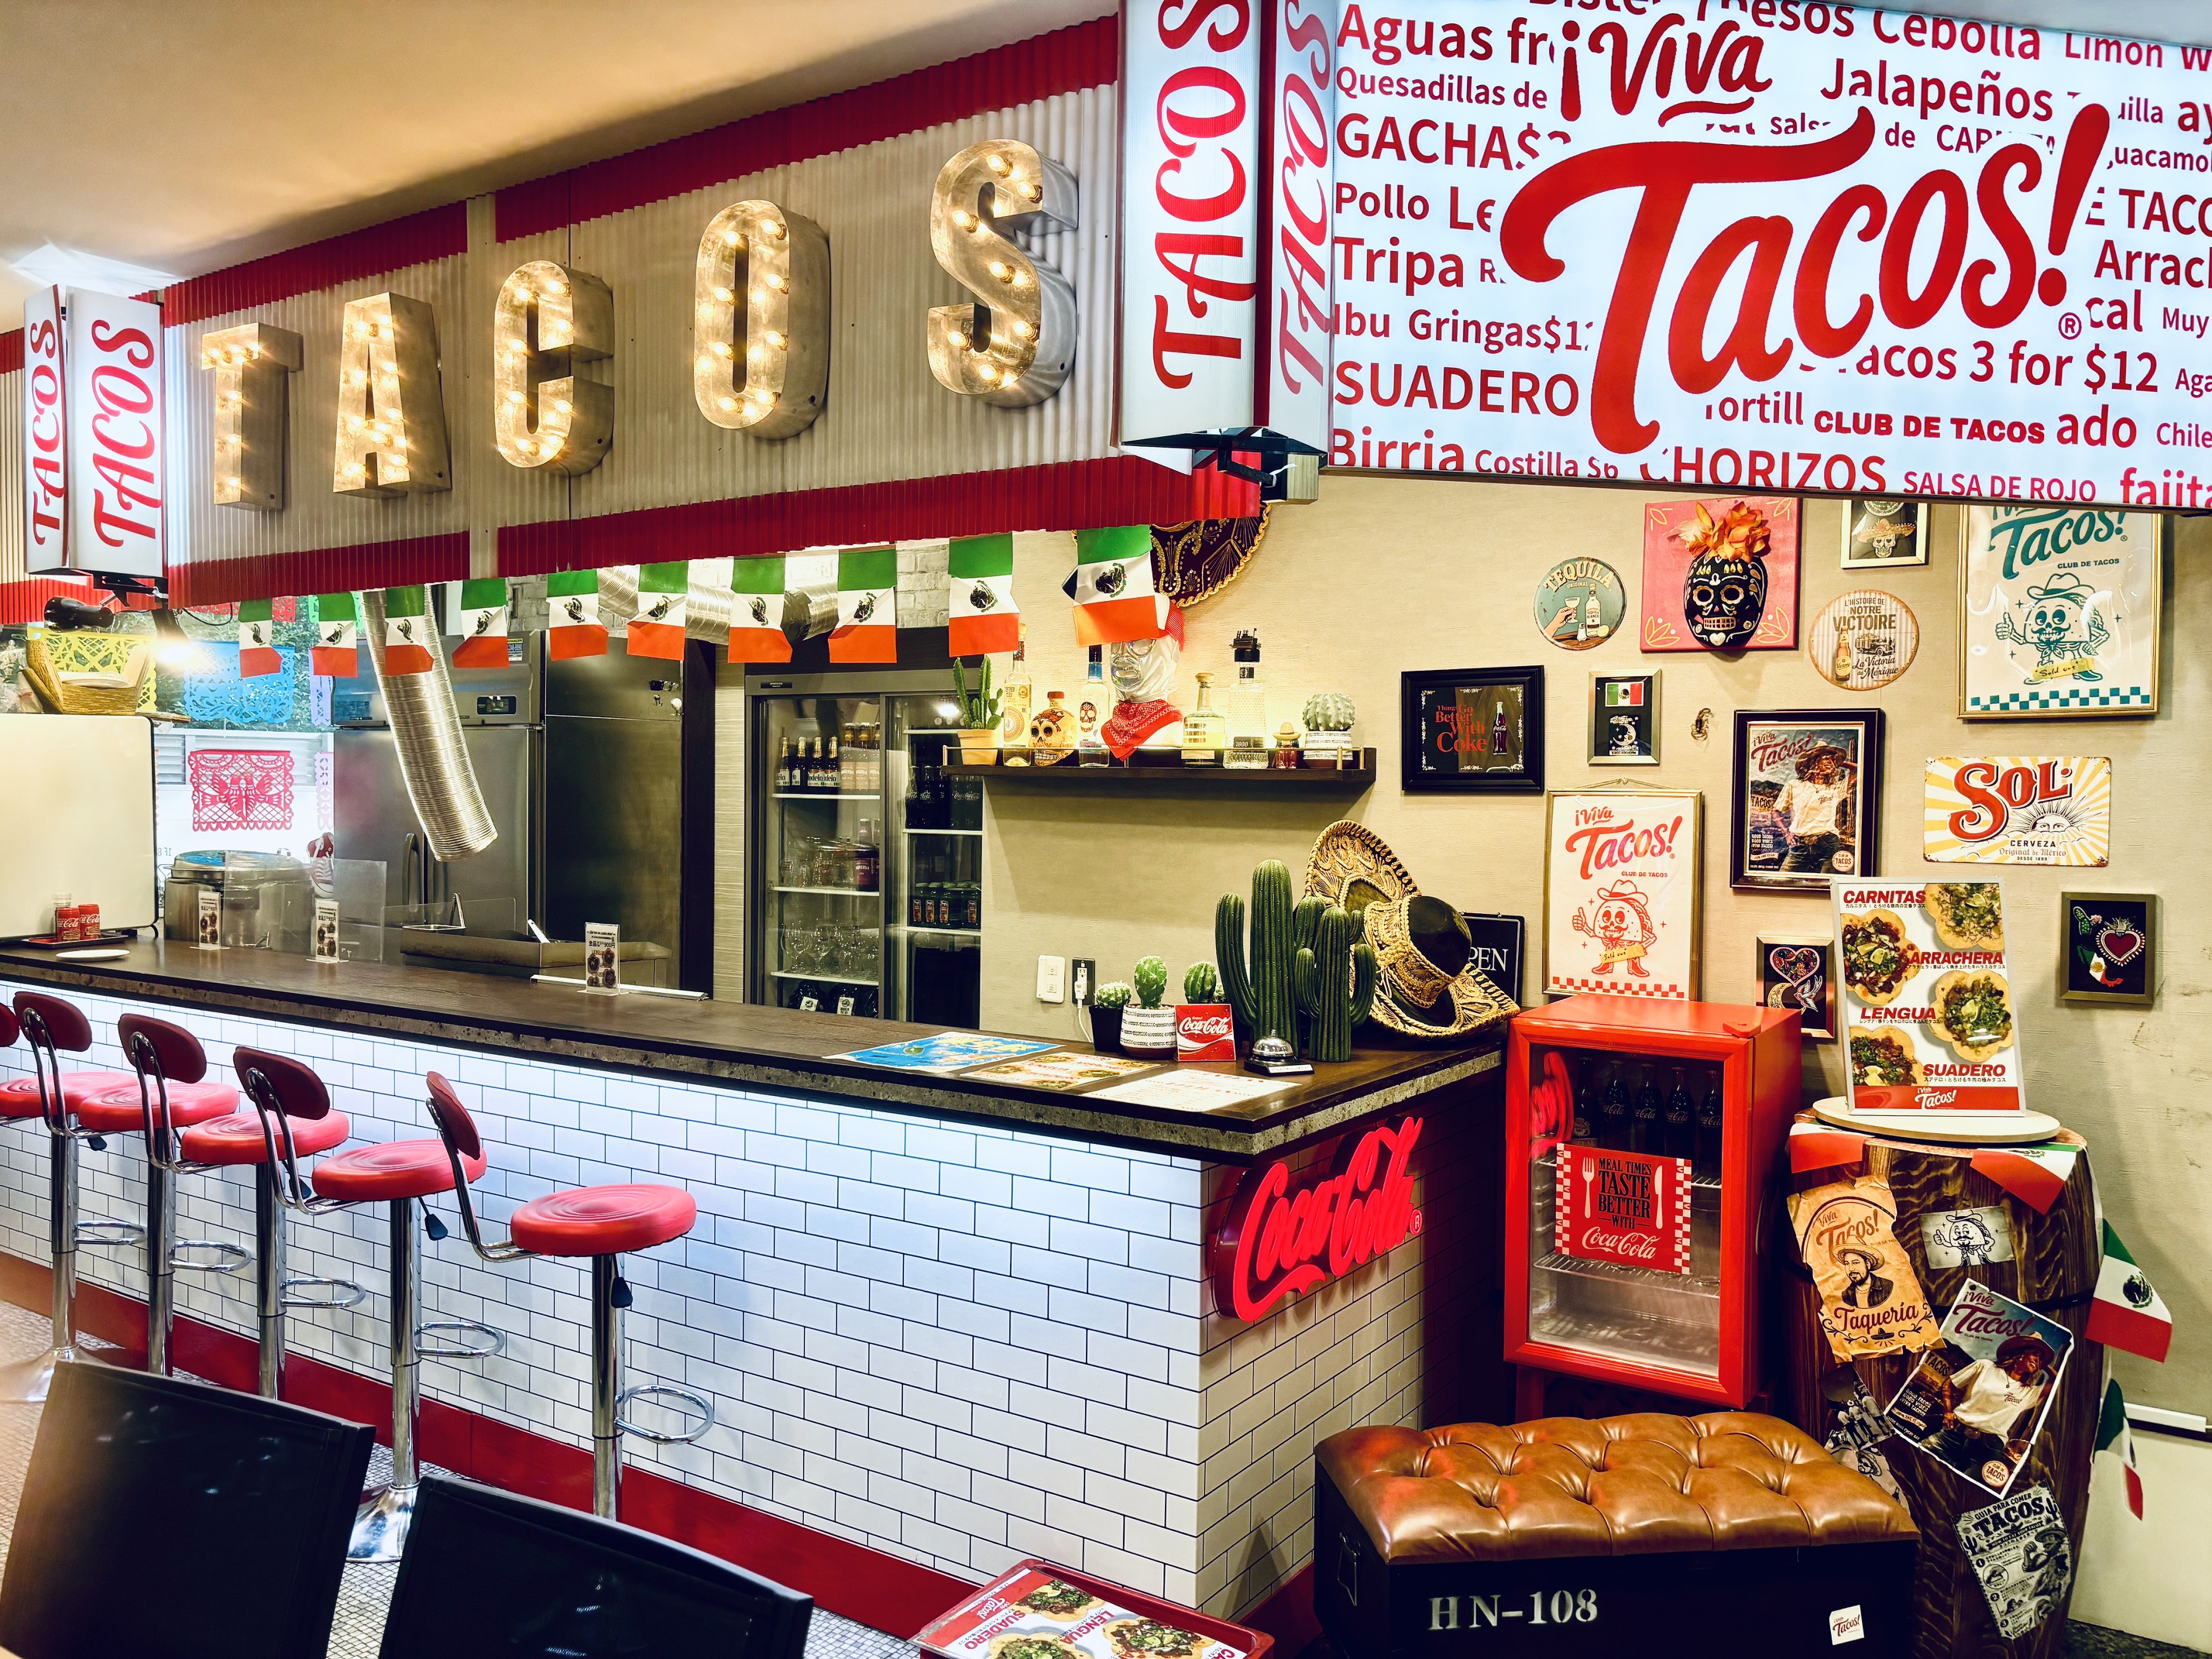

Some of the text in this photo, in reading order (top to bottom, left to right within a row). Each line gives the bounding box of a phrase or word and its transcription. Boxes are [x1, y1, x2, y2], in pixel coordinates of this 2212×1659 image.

[1337, 4, 1493, 65] Aguas
[1874, 10, 2040, 60] Cebolla
[1561, 12, 1772, 127] ¡Viva
[1337, 66, 1547, 109] Quesadillas de
[1821, 57, 2054, 122] Jalapeños
[1884, 122, 1915, 149] de
[1152, 0, 1256, 390] TACOS
[1279, 0, 1334, 394] TACOS
[1335, 181, 1430, 221] Pollo
[1333, 237, 1464, 297] Tripa
[1500, 103, 2110, 455] Tacos!
[201, 139, 1078, 510] TACOS
[2162, 307, 2210, 338] Muy
[1970, 341, 1995, 383] 3
[2009, 340, 2073, 386] for
[2084, 343, 2159, 395] $12
[1334, 360, 1579, 417] SUADERO
[30, 319, 66, 545] TACOS
[91, 319, 162, 548] TACOS
[1814, 410, 1893, 436] CLUB
[1903, 415, 1941, 439] DE
[1950, 417, 2045, 445] TACOS
[2056, 404, 2138, 448] ado
[1333, 425, 1578, 477] Birria Costilla
[1903, 471, 1981, 498] SALSA
[1991, 474, 2022, 500] DE
[2030, 477, 2097, 503] ROJO
[1543, 561, 1615, 593] TEQUILA
[2094, 558, 2120, 566] TACOS
[1832, 614, 1896, 632] VICTOIRE
[1850, 606, 1881, 615] NOTRE
[1852, 658, 1865, 669] La
[1435, 711, 1472, 723] Better
[1457, 704, 1474, 713] Go
[1437, 732, 1487, 754] Coke
[1450, 720, 1486, 734] With
[1751, 732, 1813, 773] Tacos!
[1575, 806, 1614, 826] ¡Viva
[1565, 816, 1683, 880] Tacos!
[1843, 891, 1926, 904] CARNITAS
[1469, 946, 1509, 972] PEN
[1908, 952, 2004, 964] ARRACHERA
[1179, 1016, 1231, 1036] Coca-Cola
[1860, 1007, 1936, 1019] LENGUA
[1922, 1063, 2006, 1077] SUADERO
[1914, 1089, 1957, 1110] Tacos!
[1599, 1157, 1652, 1176] MEAL TIMES
[1598, 1170, 1651, 1200] TASTE
[1598, 1193, 1650, 1219] BETTER
[1612, 1214, 1636, 1230] WITH
[1582, 1226, 1661, 1259] Coca-Cola
[1833, 1301, 1920, 1335] Taquería
[1953, 1304, 2035, 1337] Tacos!
[1925, 1352, 1951, 1377] TACOS
[1986, 1466, 2005, 1482] TACOS
[1972, 1496, 2045, 1538] TACOS
[1992, 1501, 2011, 1513] PARA
[2011, 1493, 2032, 1506] COMER
[964, 1609, 1026, 1650] SUADERO
[1060, 1610, 1115, 1644] LENGUA
[1832, 1614, 1860, 1637] Tacos!
